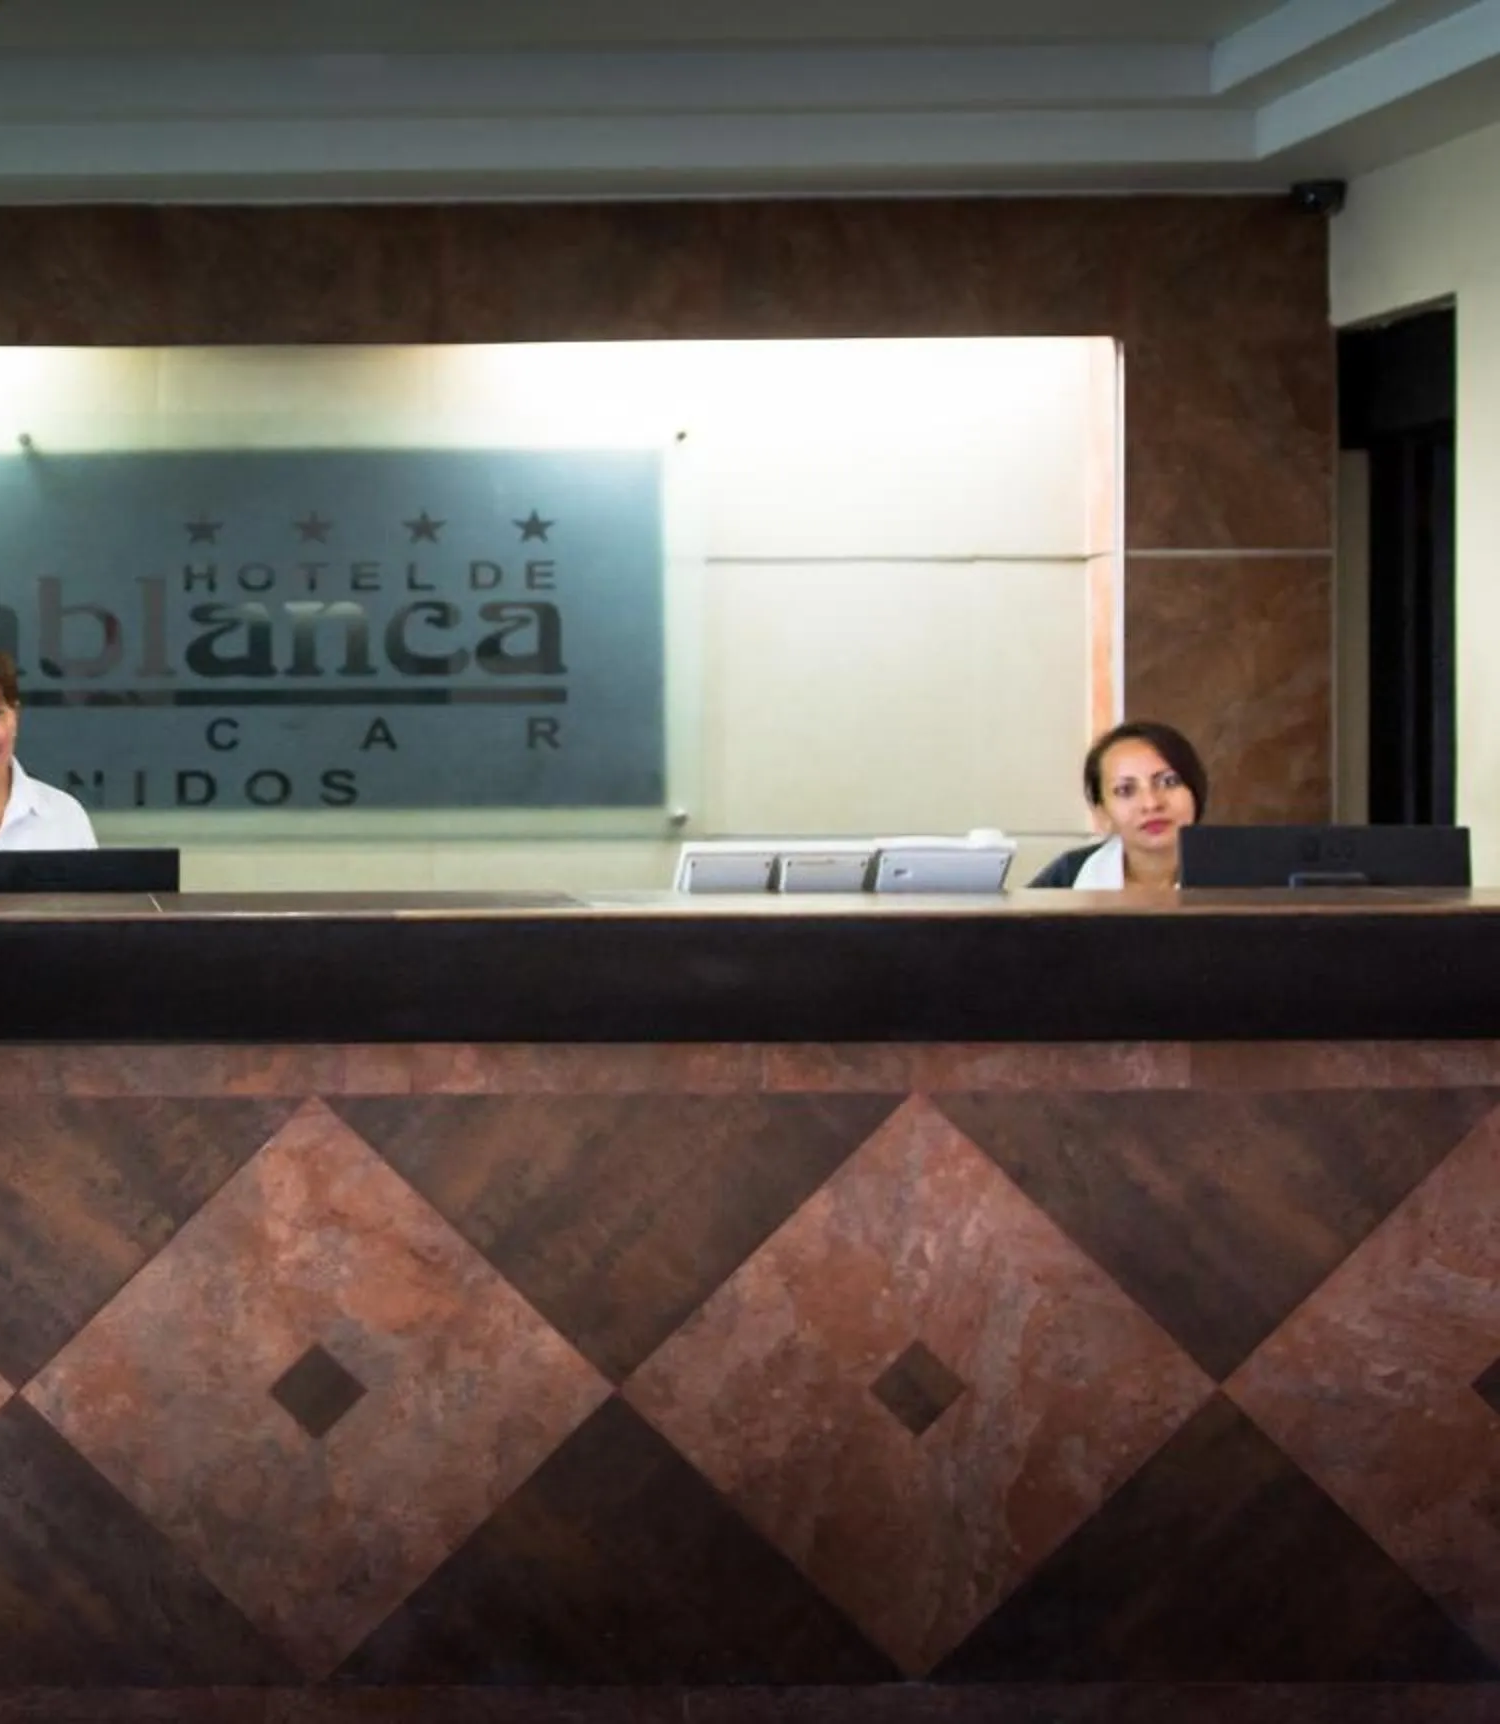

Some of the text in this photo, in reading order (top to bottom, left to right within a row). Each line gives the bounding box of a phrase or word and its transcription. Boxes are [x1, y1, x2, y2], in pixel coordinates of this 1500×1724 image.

[185, 561, 557, 592] HOTEL DE
[206, 718, 562, 750] CAR
